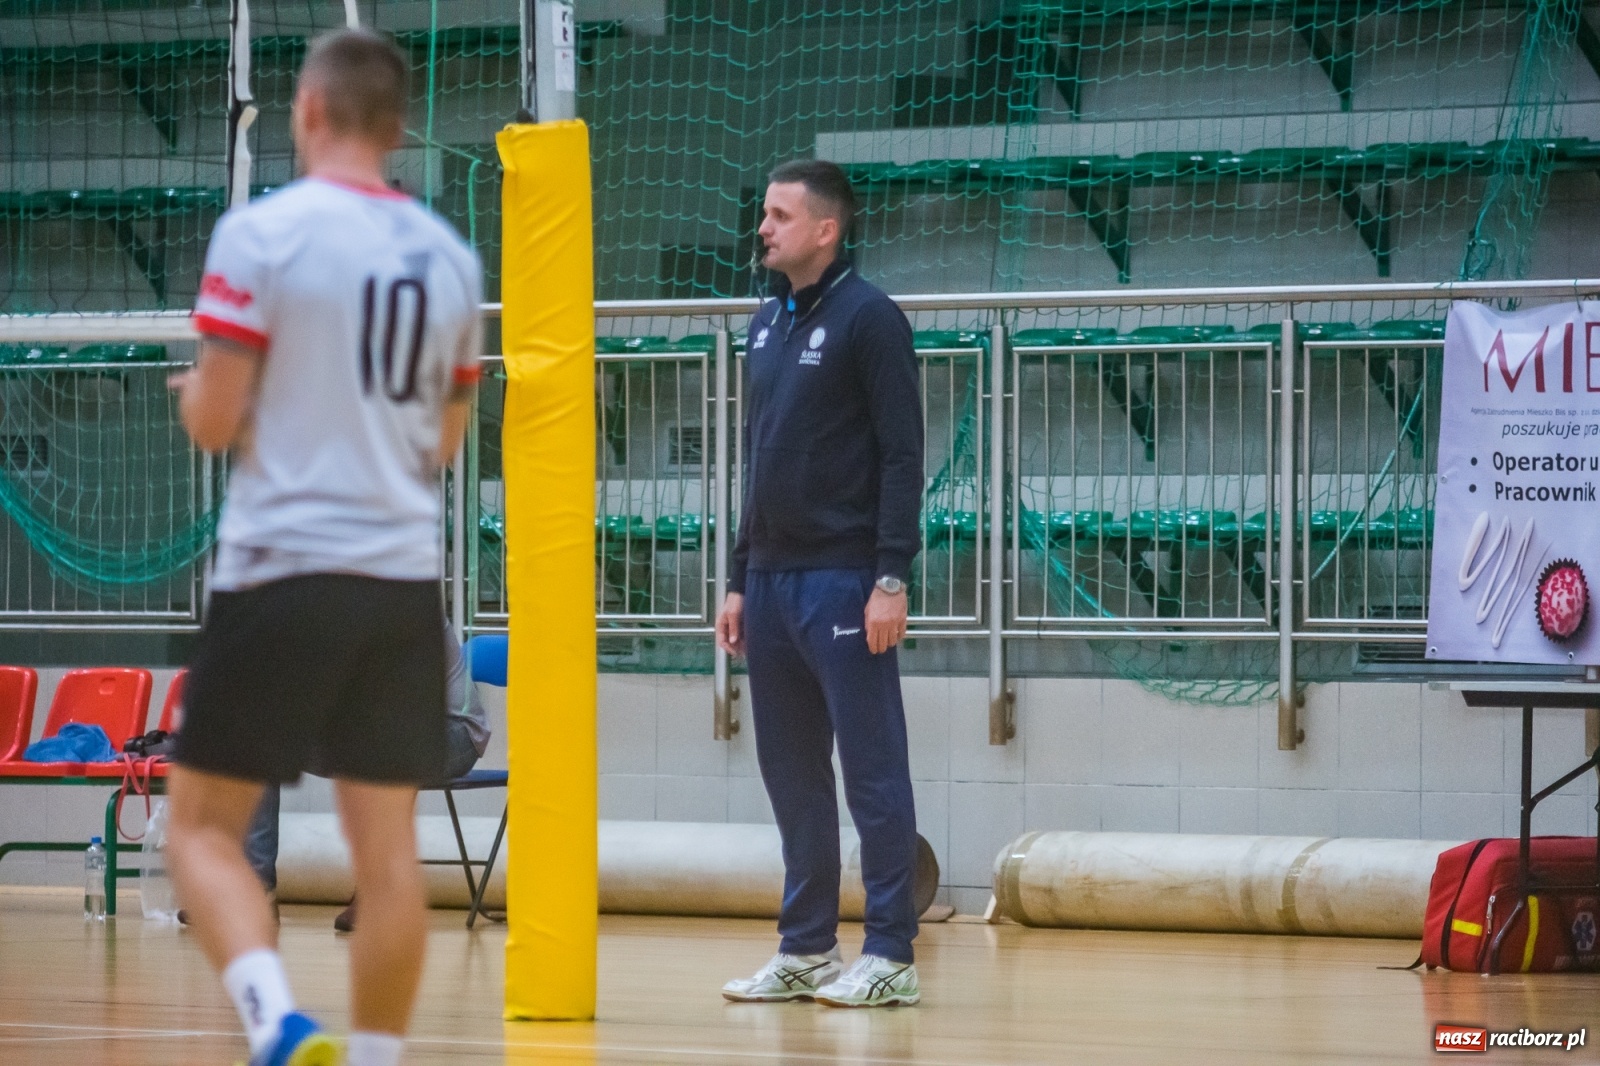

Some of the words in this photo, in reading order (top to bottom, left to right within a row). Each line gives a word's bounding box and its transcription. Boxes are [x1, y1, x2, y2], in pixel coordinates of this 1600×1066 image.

[360, 275, 428, 402] 10
[1527, 408, 1553, 416] Mieszko
[1502, 421, 1581, 440] poszukuje
[1583, 424, 1600, 439] pra
[1493, 451, 1586, 476] Operator
[1495, 481, 1597, 502] Pracownik
